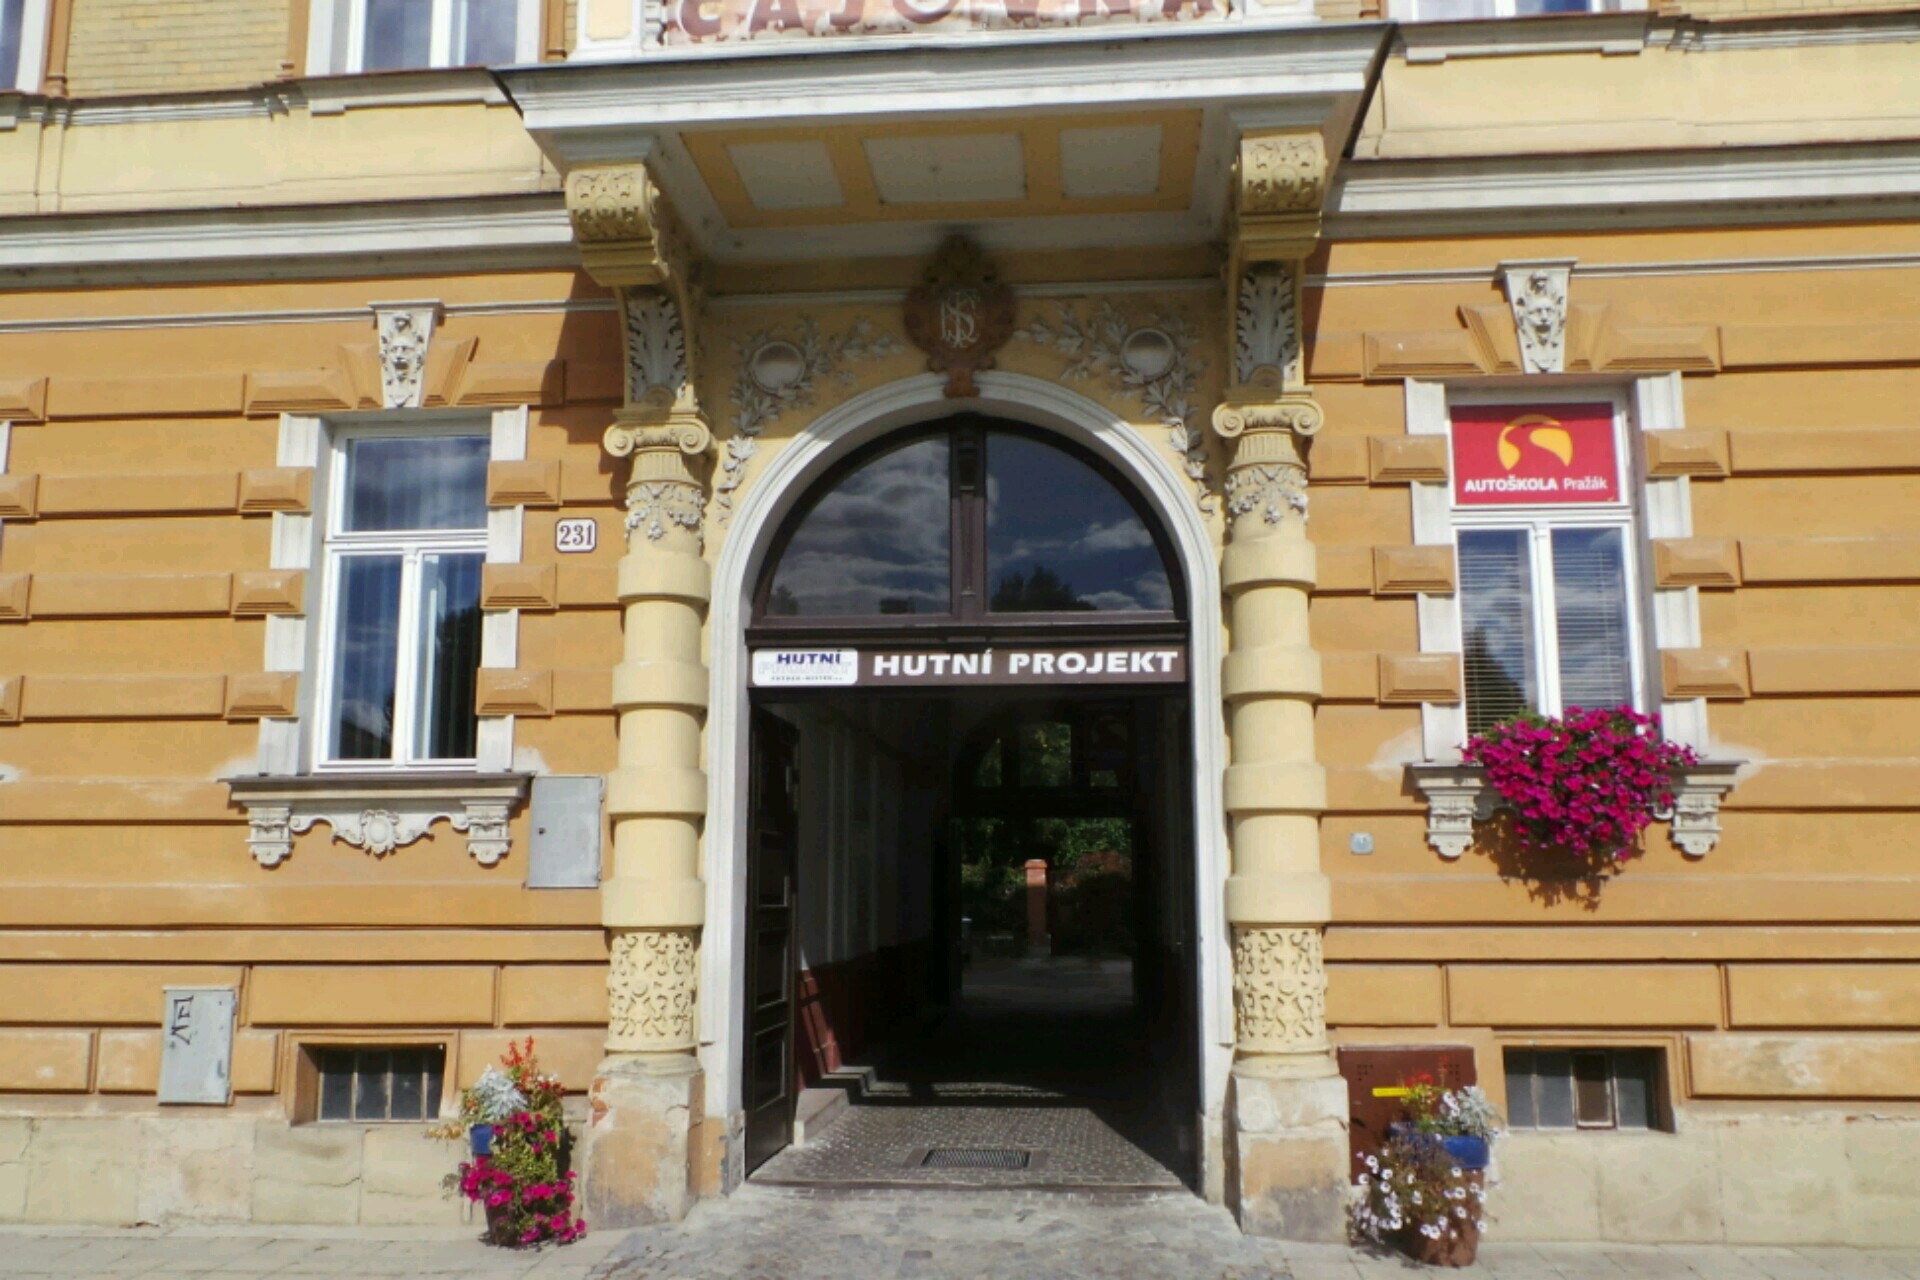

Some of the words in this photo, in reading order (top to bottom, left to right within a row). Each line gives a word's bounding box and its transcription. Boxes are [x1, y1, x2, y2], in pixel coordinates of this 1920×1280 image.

[1464, 475, 1558, 493] AUTOŠKOLA
[1563, 475, 1608, 491] Pražák
[559, 524, 593, 546] 231
[873, 648, 994, 676] HUTNÍ
[1008, 651, 1179, 674] PROJEKT
